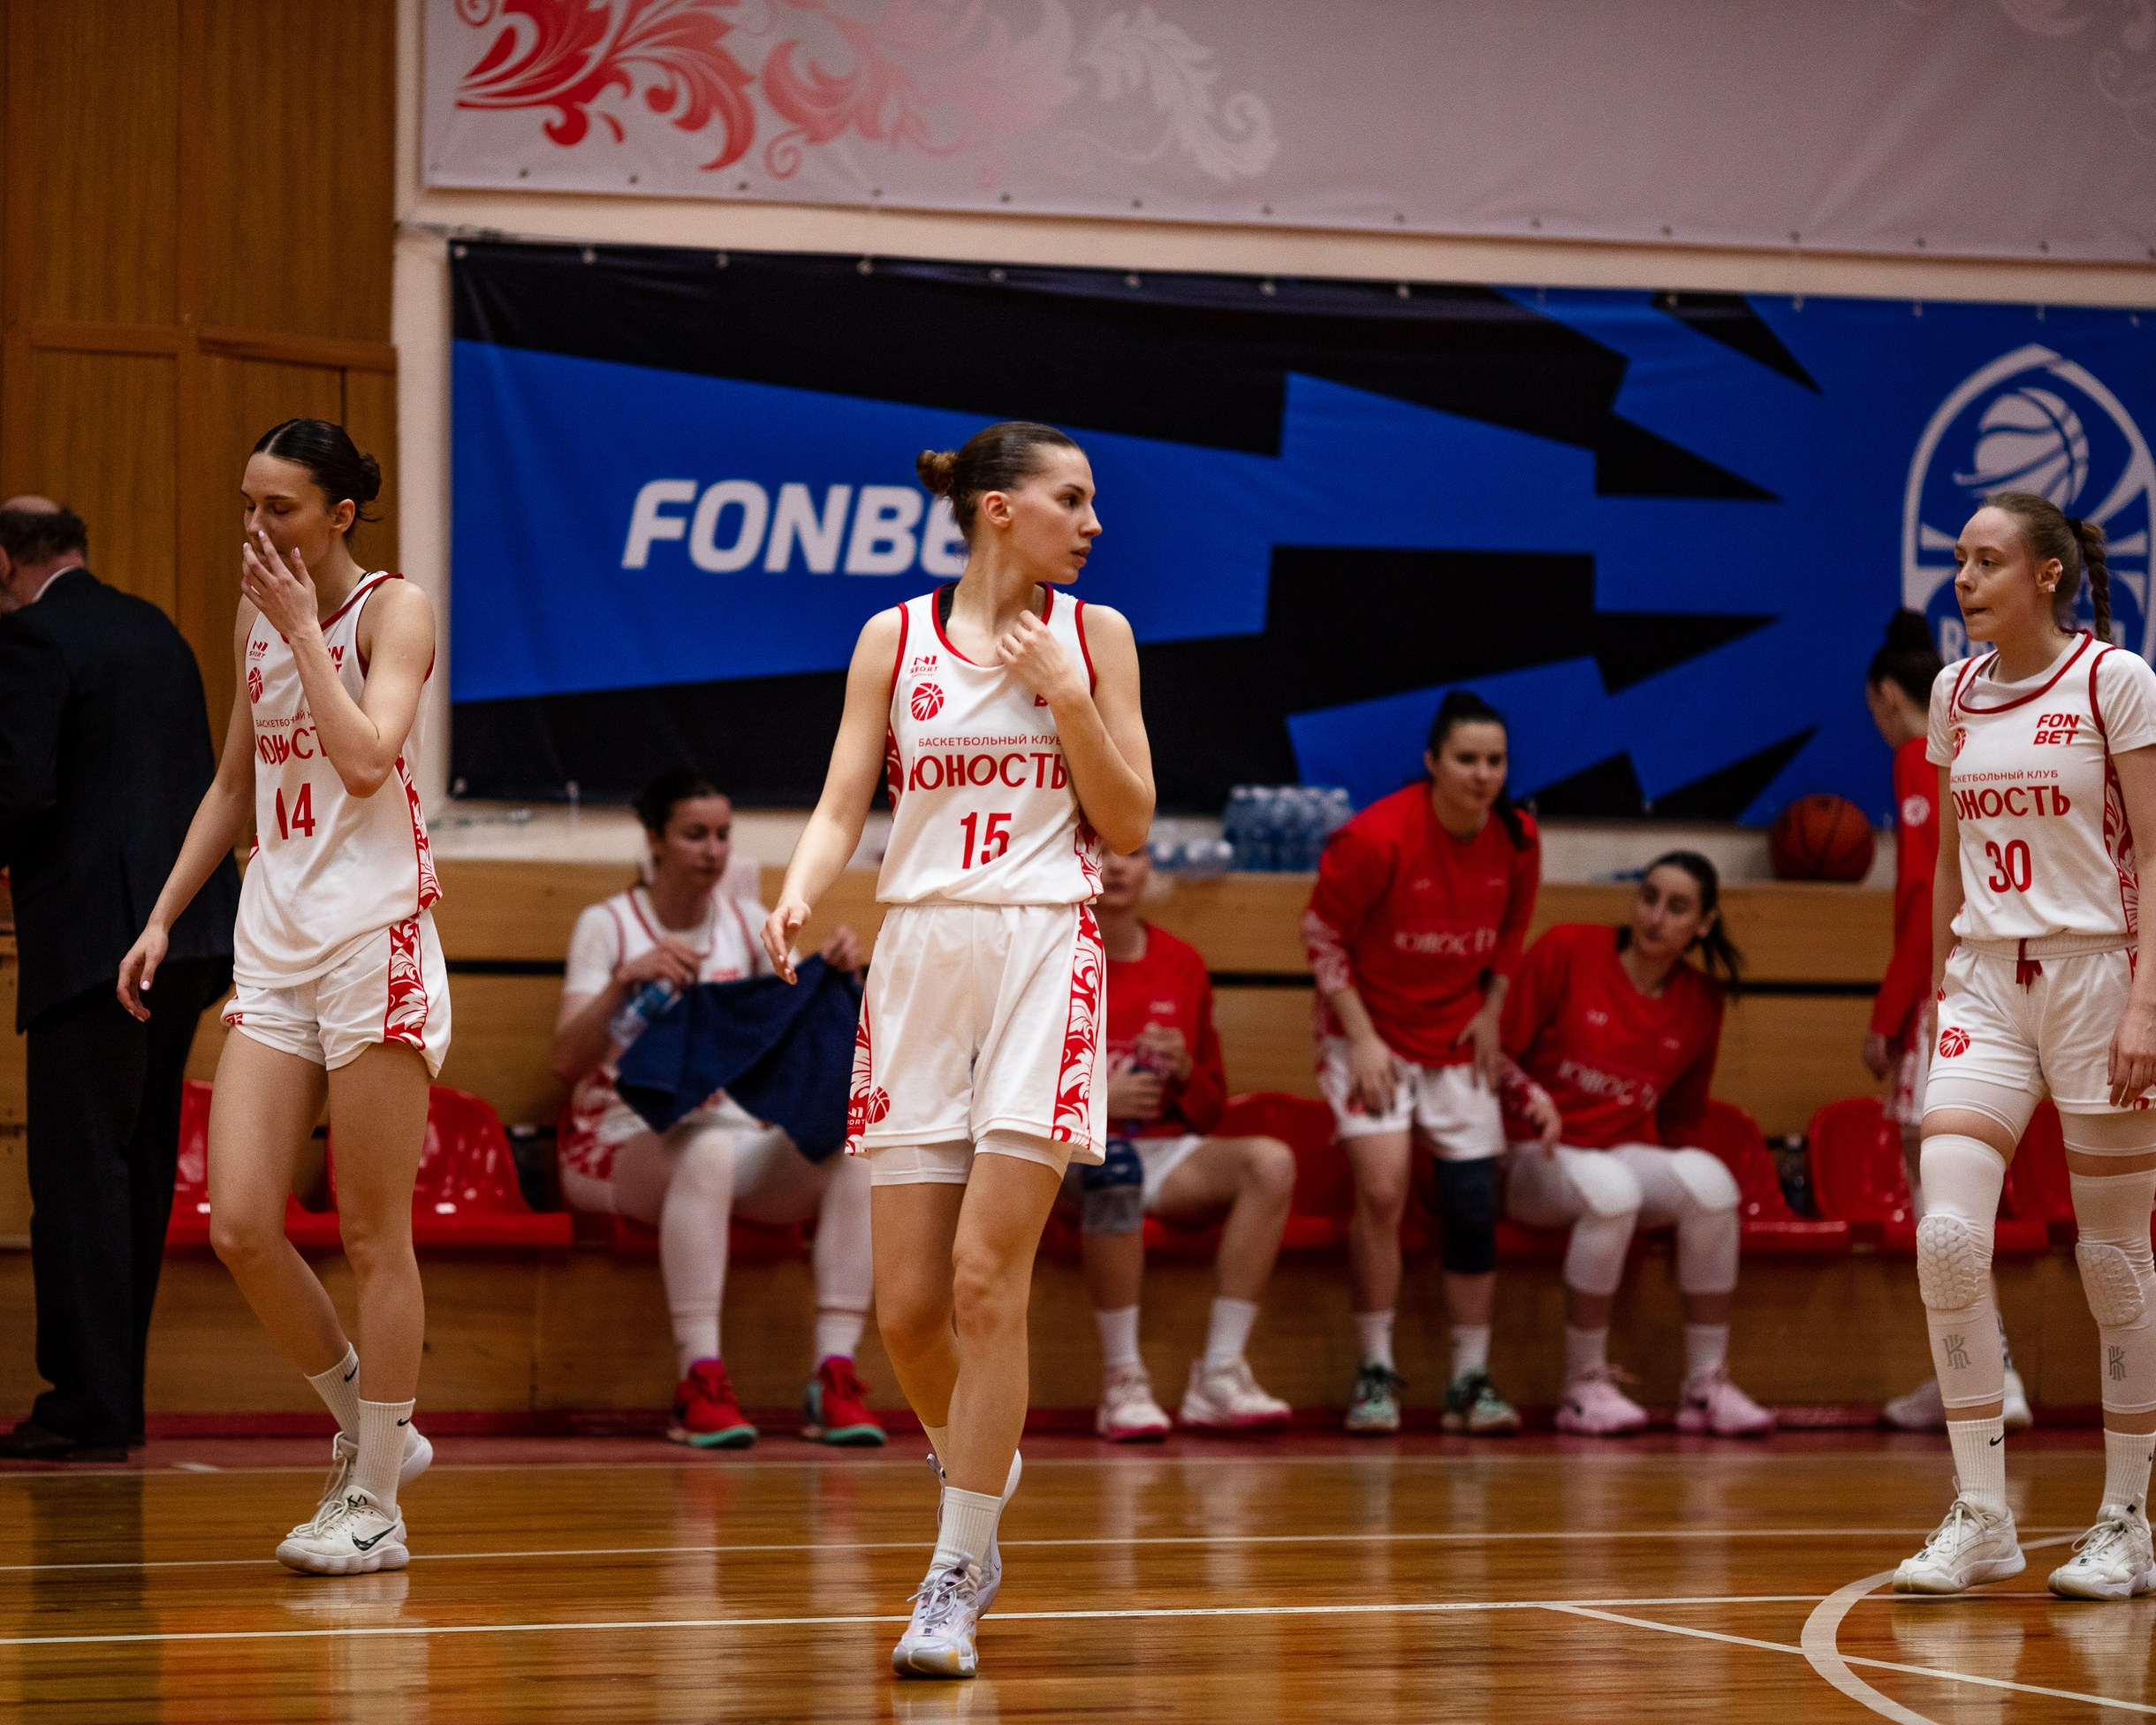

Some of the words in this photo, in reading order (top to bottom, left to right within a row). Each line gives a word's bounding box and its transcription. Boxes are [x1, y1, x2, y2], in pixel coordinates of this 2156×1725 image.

[621, 479, 967, 576] FONBE
[2033, 730, 2079, 745] BET
[2037, 713, 2080, 728] FON
[918, 733, 1027, 747] БАСКЕТБОЛЬНЫЙ
[908, 753, 1067, 791] ЮНОСТЬ
[1951, 770, 2023, 783] АСКЕТБОЛЬНЫЙ
[2027, 770, 2059, 779] КЛУБ
[276, 783, 315, 840] 14
[960, 812, 1012, 870] 15
[1985, 840, 2032, 893] 30
